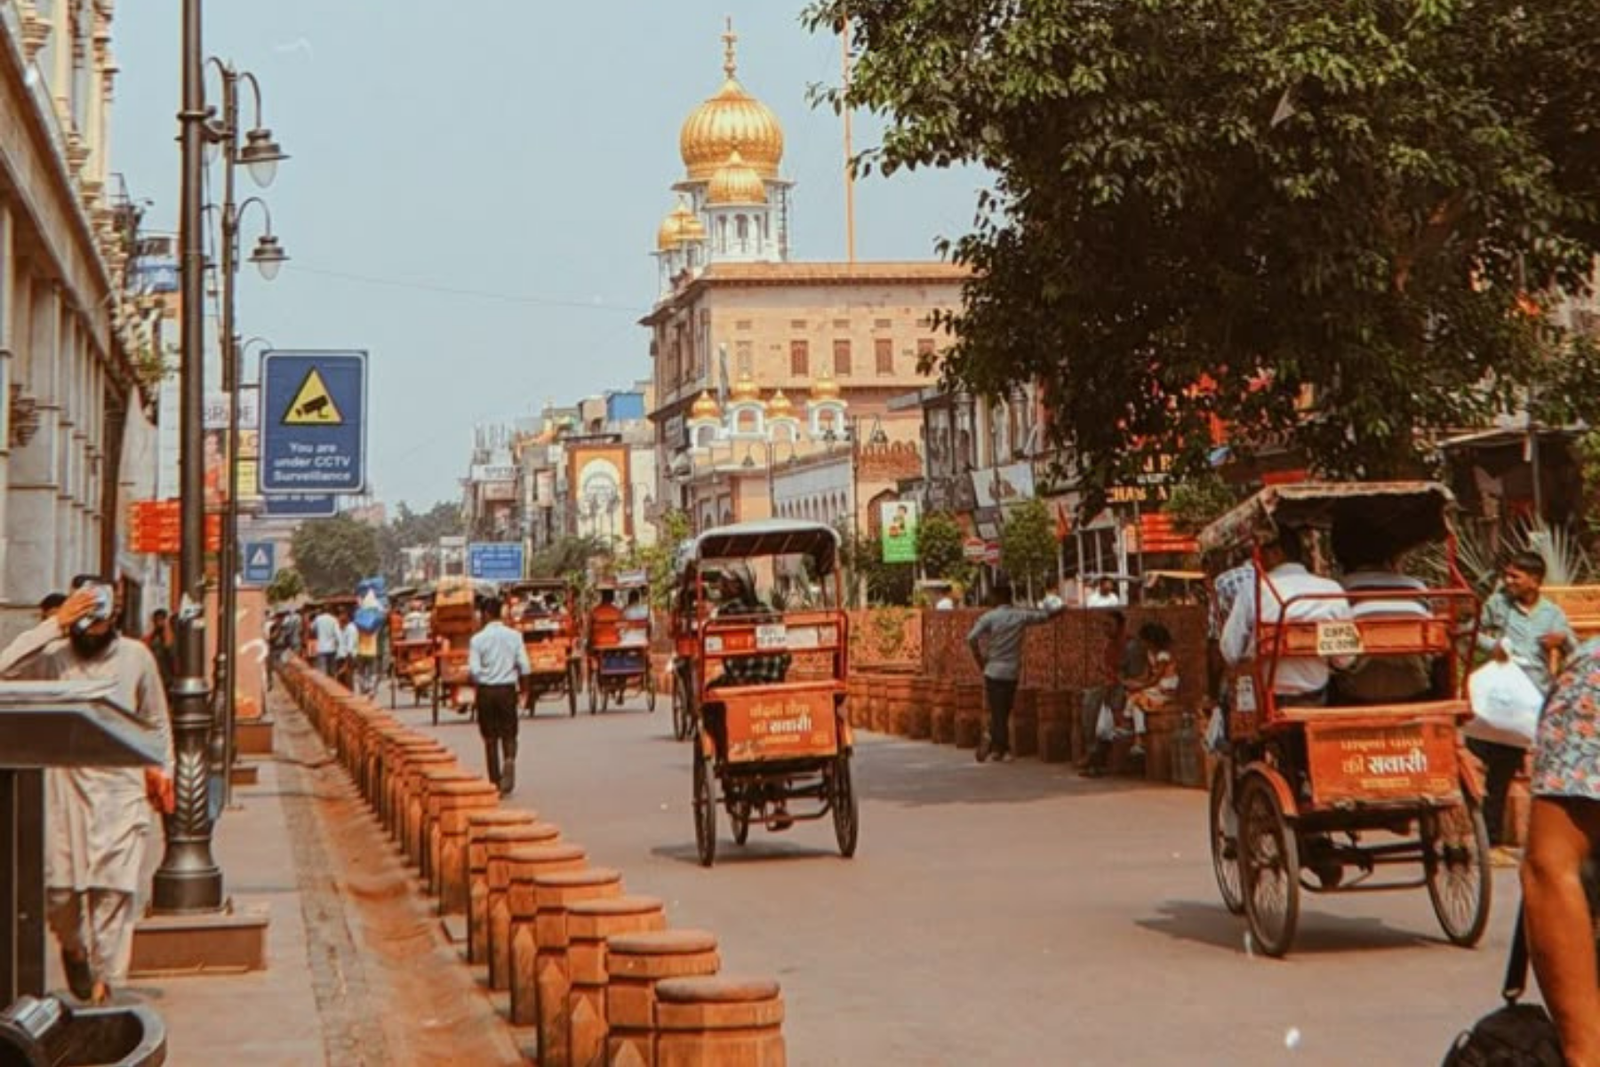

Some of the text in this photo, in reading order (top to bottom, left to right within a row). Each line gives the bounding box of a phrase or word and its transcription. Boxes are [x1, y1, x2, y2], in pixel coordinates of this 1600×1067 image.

[289, 443, 337, 453] You are
[274, 456, 350, 468] under CCTV
[274, 471, 350, 481] Surveillance
